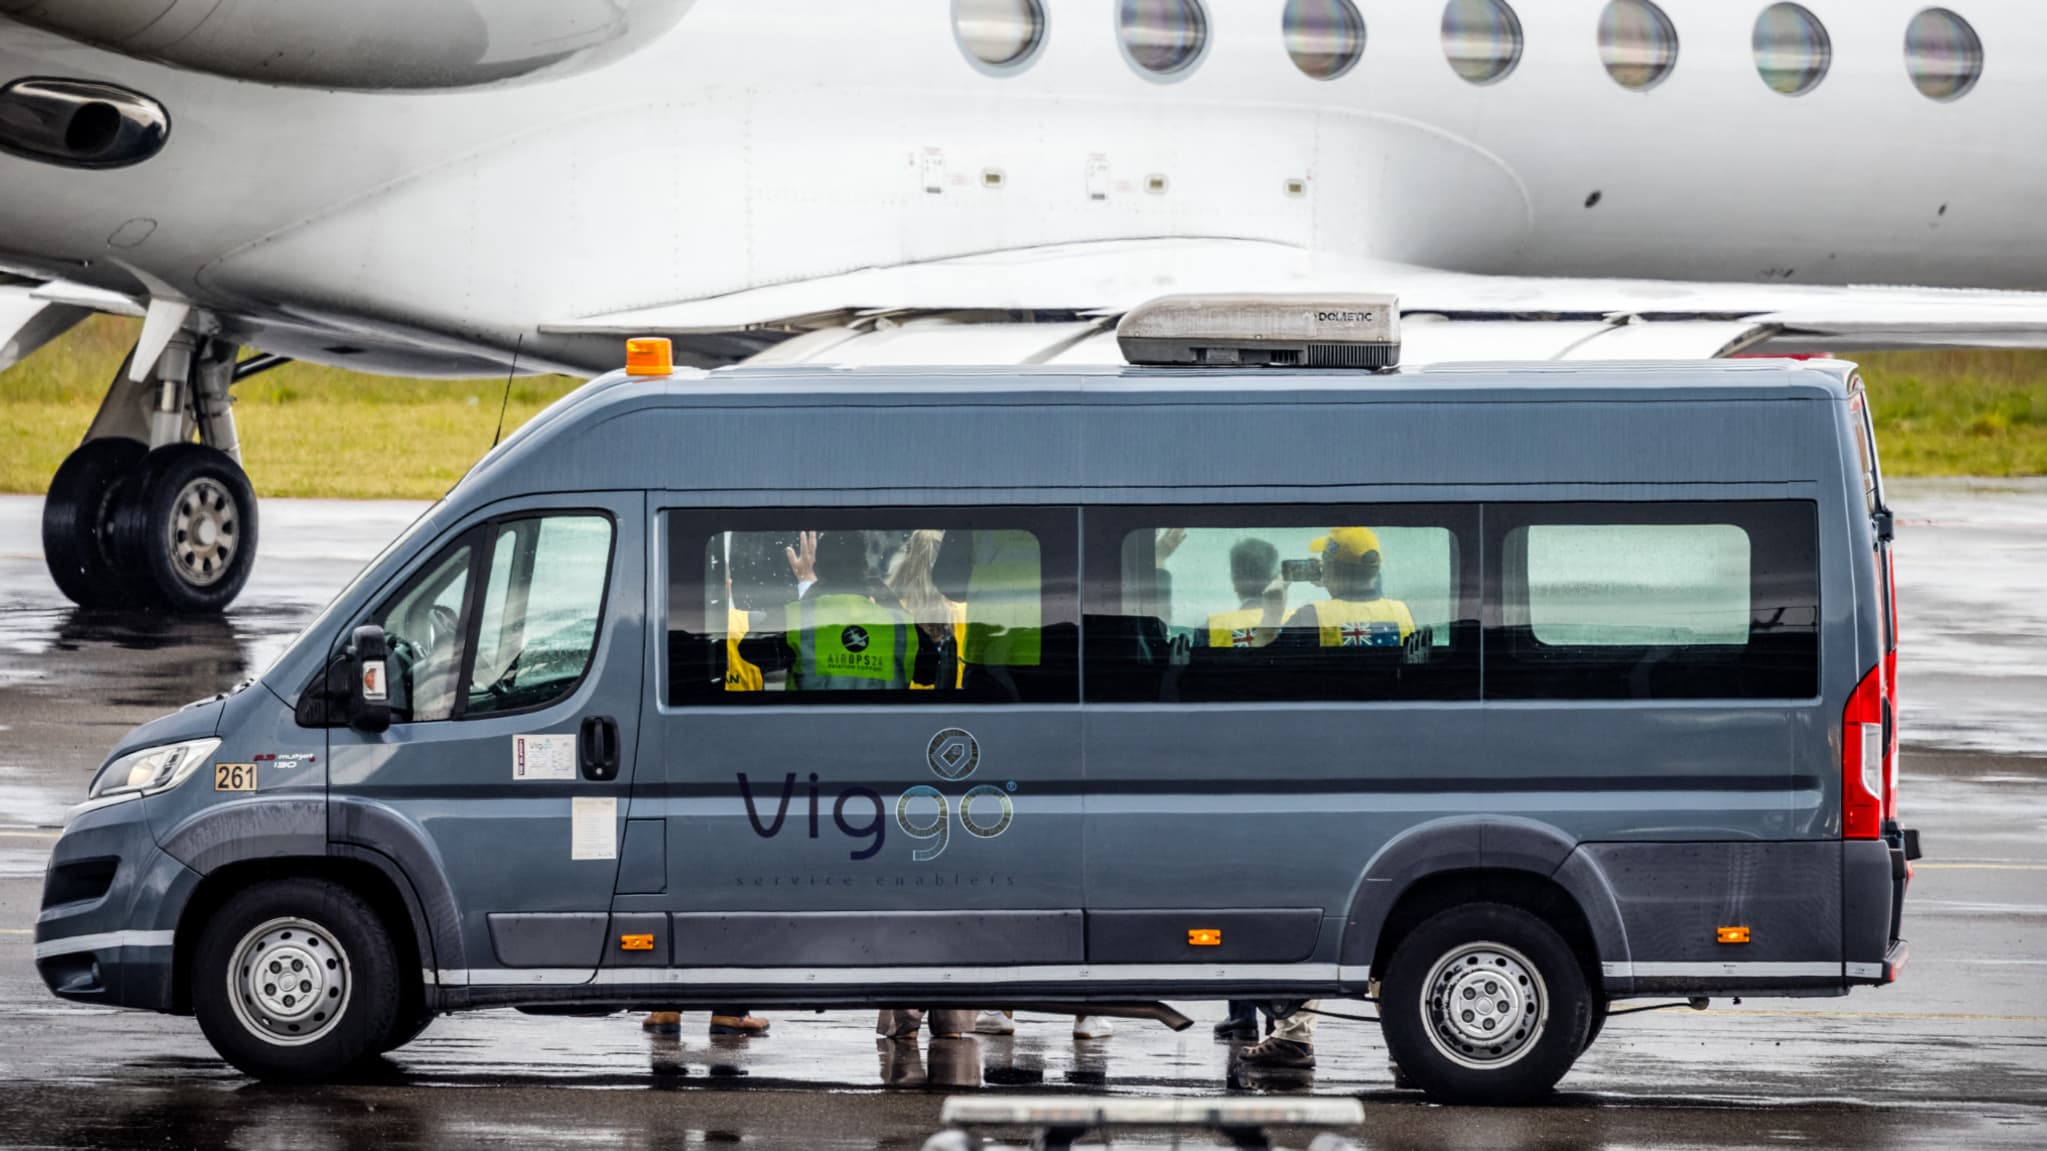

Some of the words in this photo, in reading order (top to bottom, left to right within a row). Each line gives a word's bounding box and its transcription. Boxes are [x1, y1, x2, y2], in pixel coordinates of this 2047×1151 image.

[1318, 311, 1373, 321] DOMETIC
[217, 766, 254, 789] 261
[736, 772, 1014, 861] Viggo
[735, 874, 854, 887] service
[875, 873, 1016, 887] enablers
